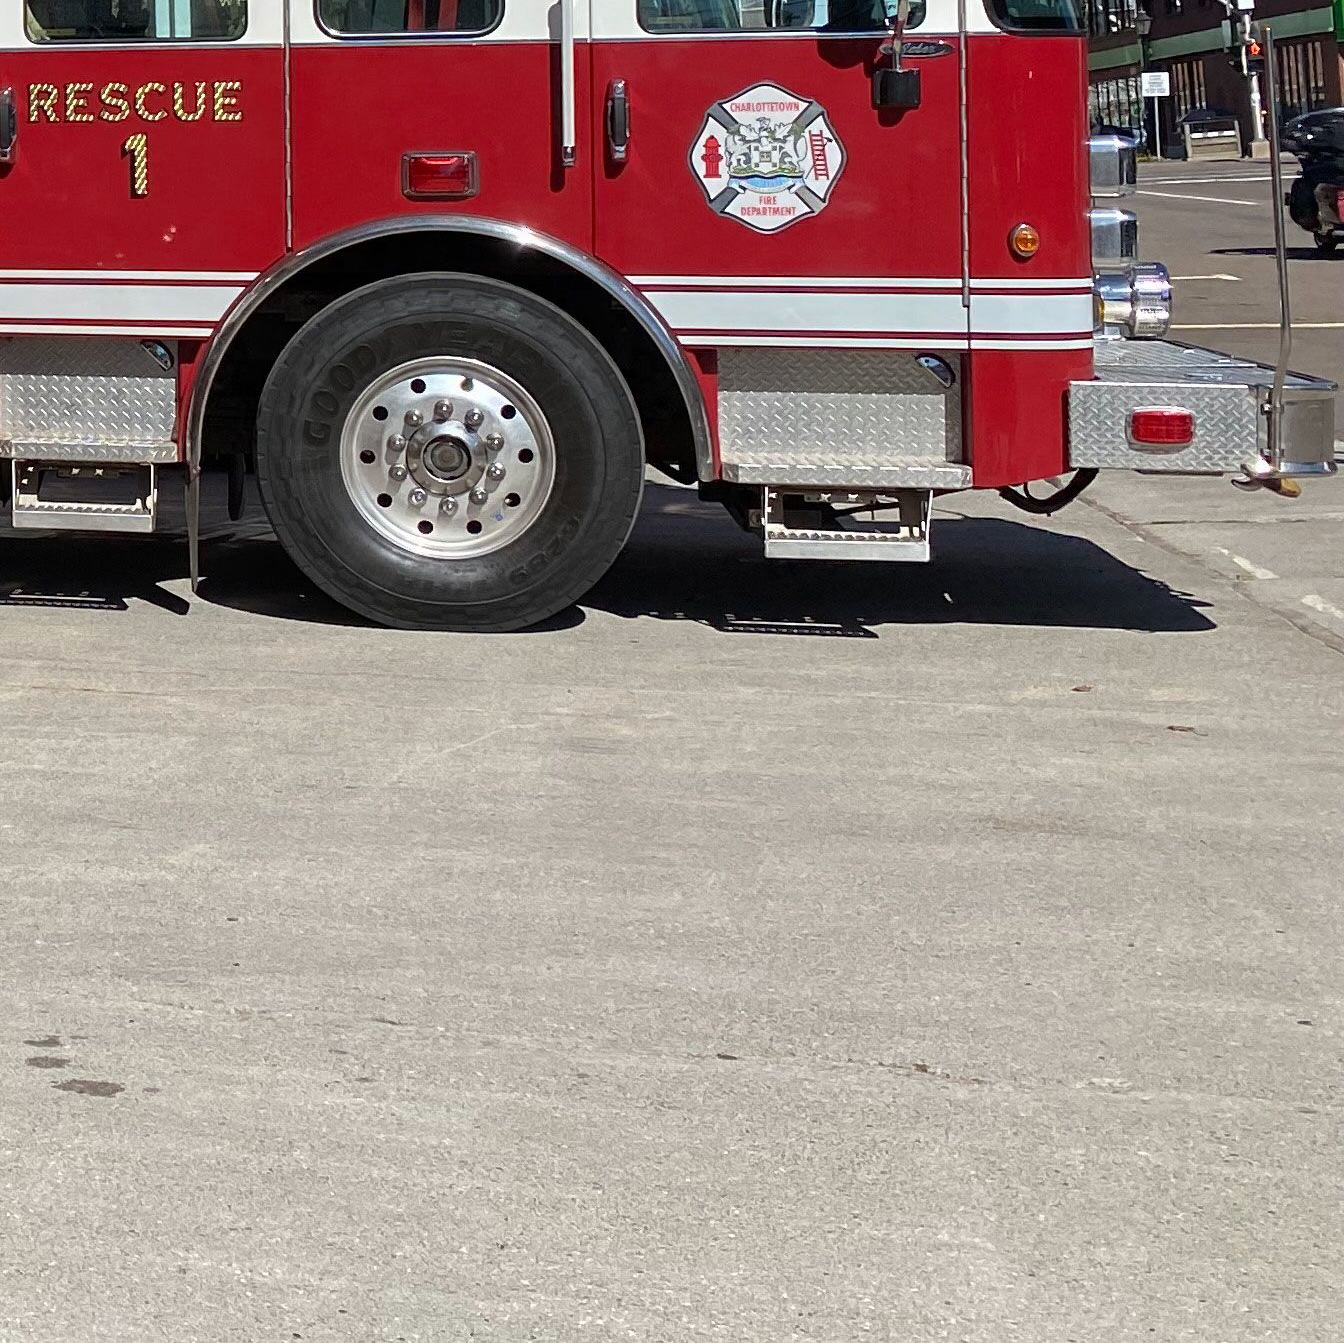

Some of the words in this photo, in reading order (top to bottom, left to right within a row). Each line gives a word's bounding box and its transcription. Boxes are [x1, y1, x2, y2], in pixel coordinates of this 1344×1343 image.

[28, 81, 243, 122] RESCUE
[730, 101, 800, 112] CHARLOTTETOWN
[122, 133, 149, 196] 1
[759, 196, 777, 205] FIRE
[740, 207, 796, 216] DEPARTMENT
